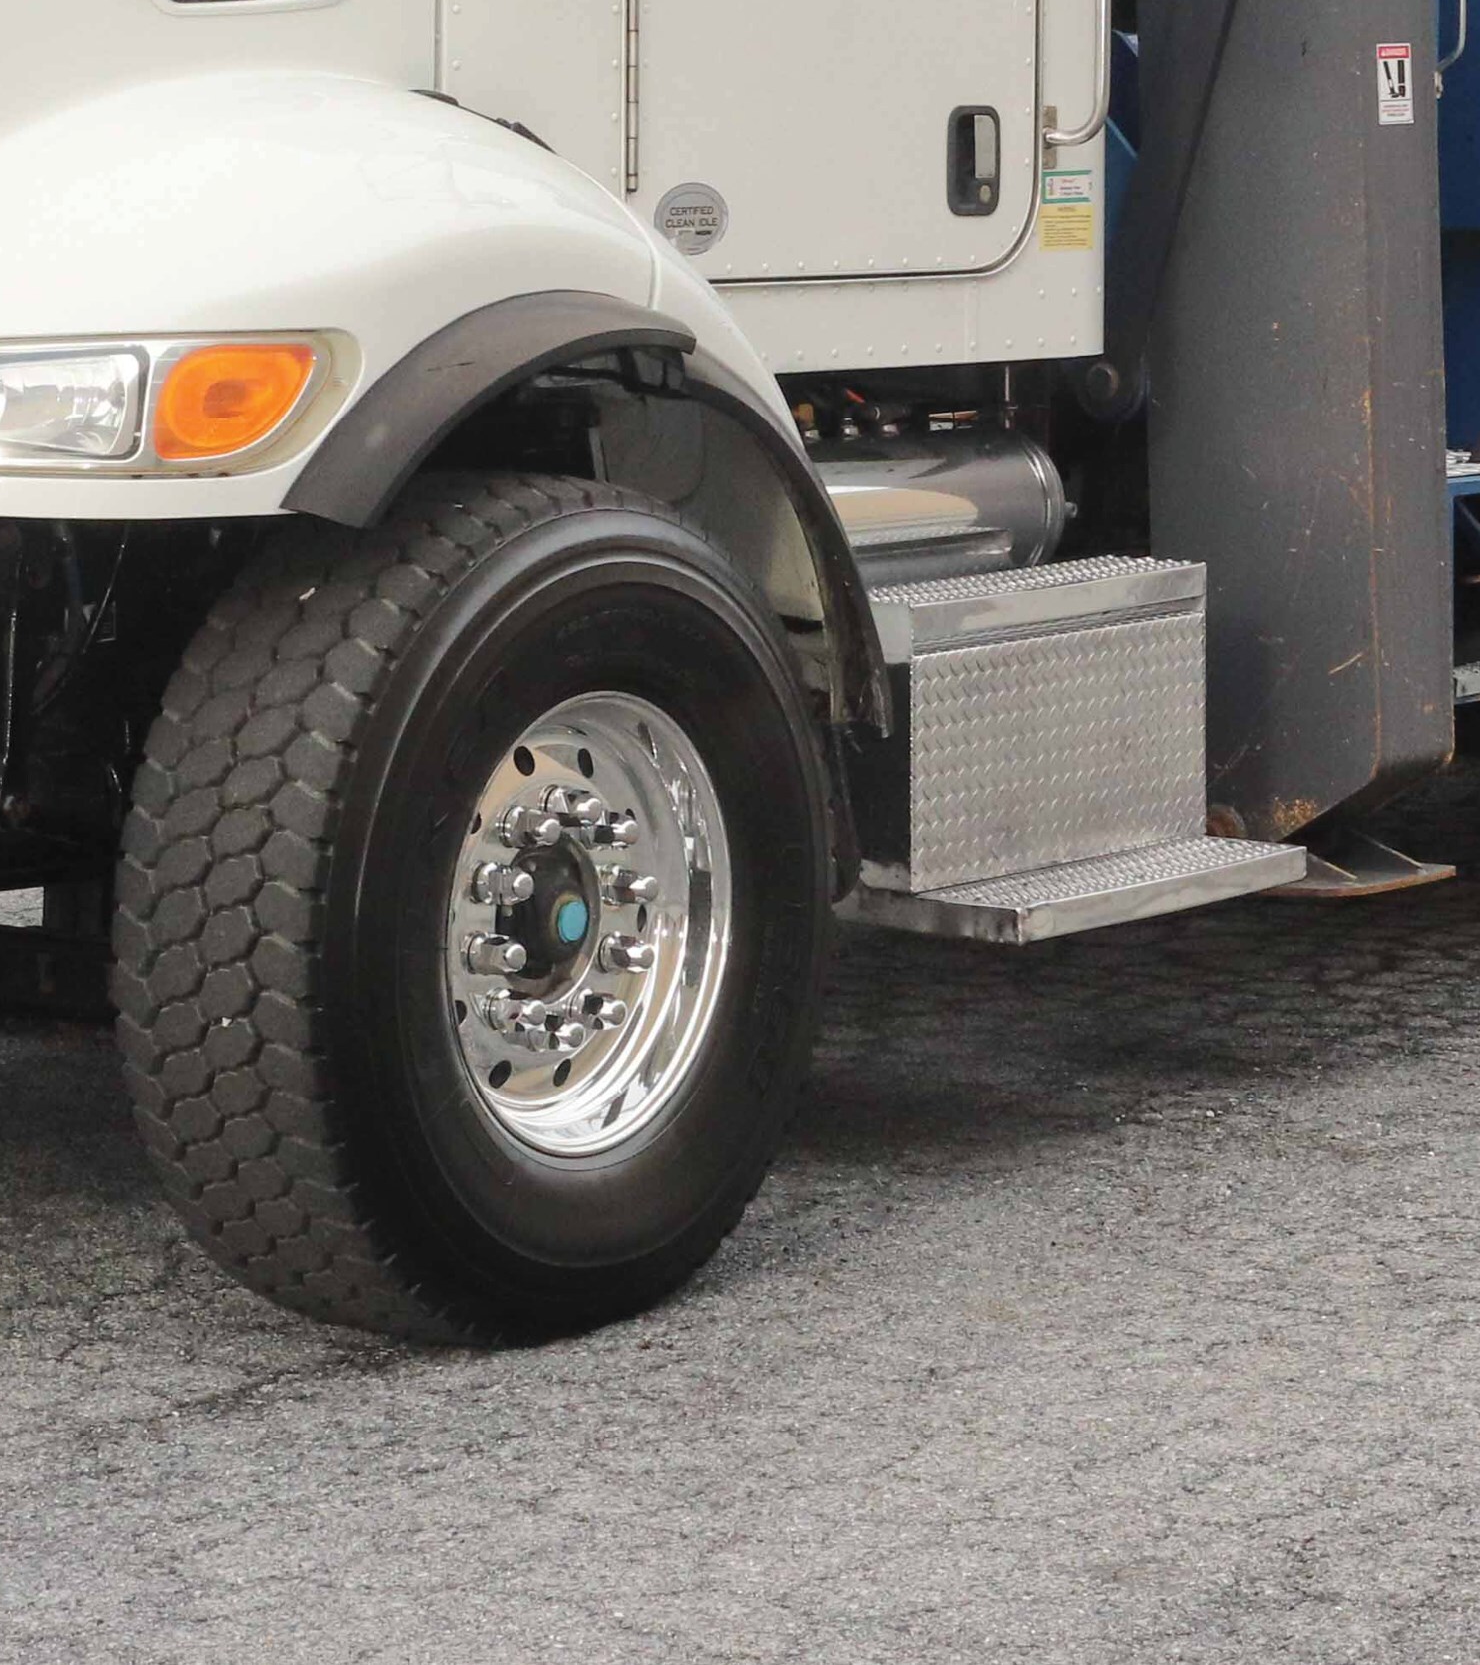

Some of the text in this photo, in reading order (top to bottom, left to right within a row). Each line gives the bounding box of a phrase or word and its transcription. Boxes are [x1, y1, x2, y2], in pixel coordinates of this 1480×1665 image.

[670, 206, 714, 216] CERTIFIED
[665, 217, 718, 228] CLEAN IDLE
